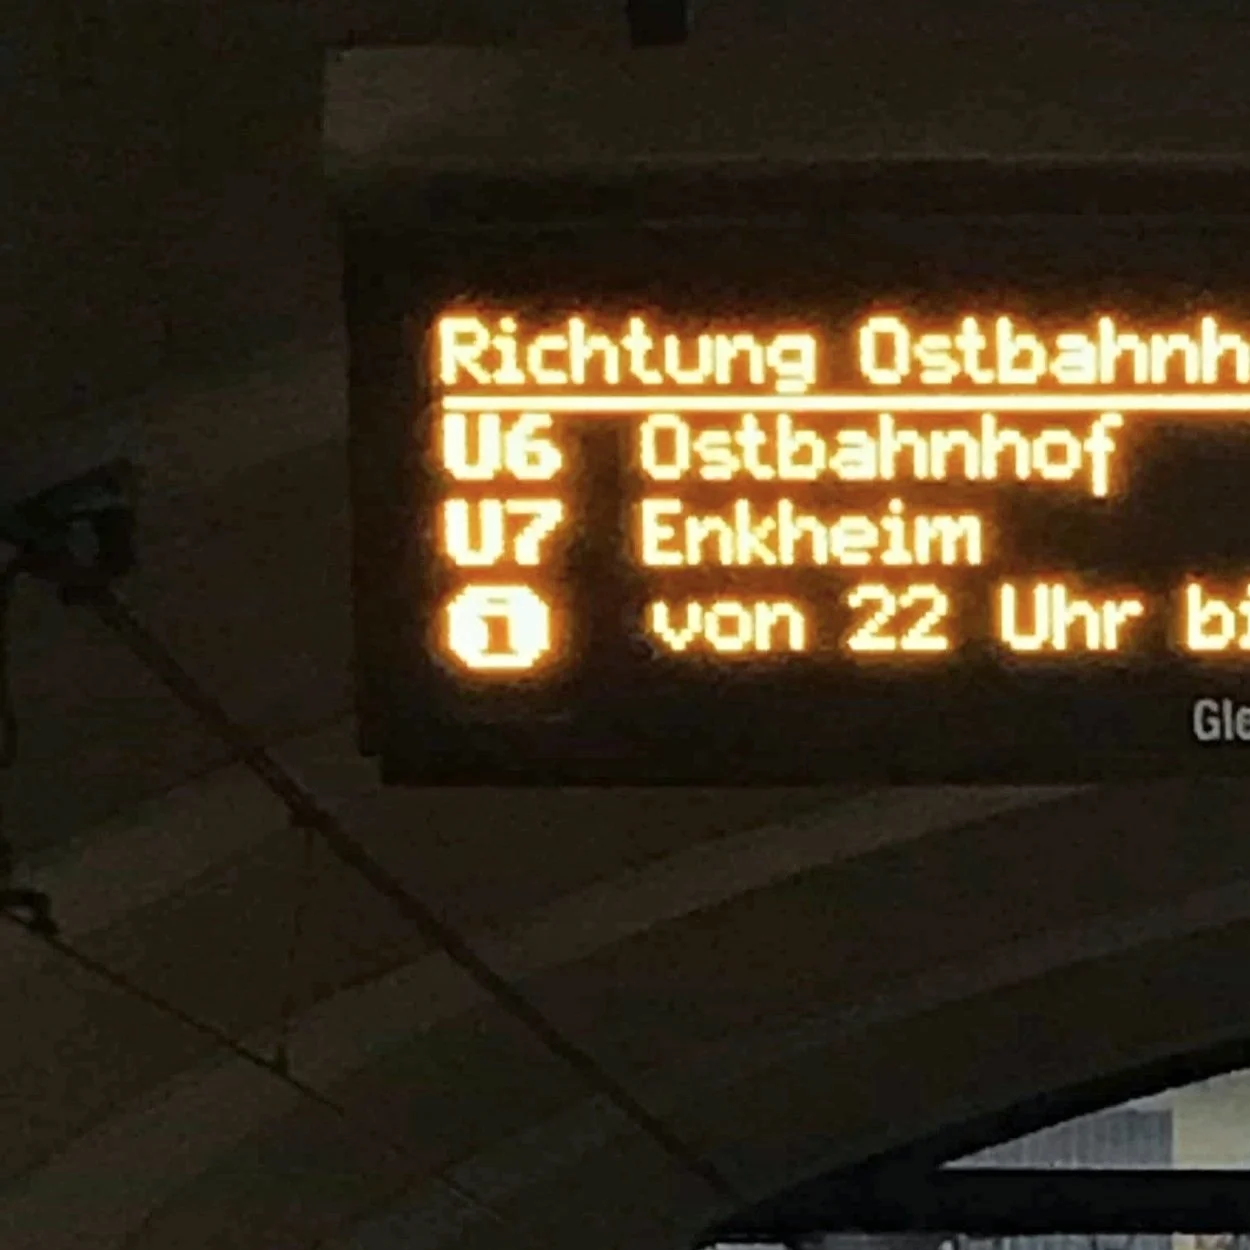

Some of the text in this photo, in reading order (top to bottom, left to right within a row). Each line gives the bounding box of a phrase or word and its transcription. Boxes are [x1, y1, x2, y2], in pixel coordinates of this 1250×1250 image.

[438, 317, 817, 392] Richtung
[442, 413, 562, 480] U6
[640, 413, 1123, 497] Ostbahnhof
[444, 499, 563, 566] U7
[642, 499, 981, 565] Enkheim
[652, 601, 804, 651] von
[848, 584, 948, 650] 22
[1000, 583, 1143, 650] Uhr
